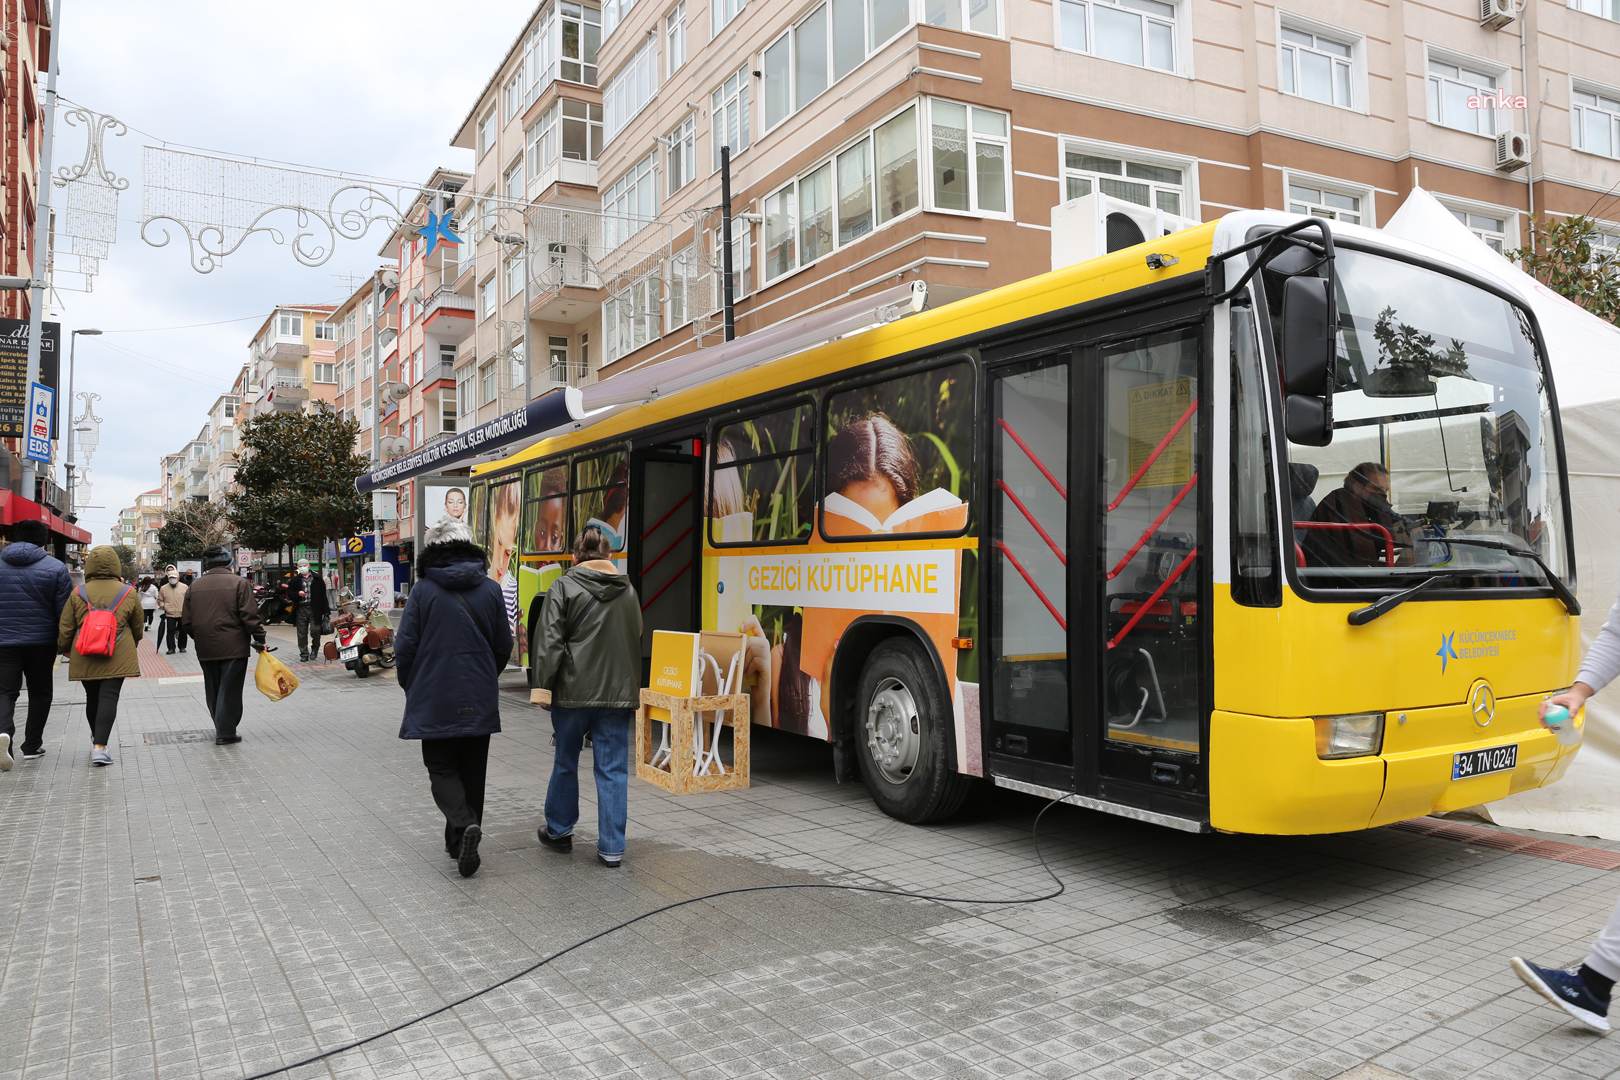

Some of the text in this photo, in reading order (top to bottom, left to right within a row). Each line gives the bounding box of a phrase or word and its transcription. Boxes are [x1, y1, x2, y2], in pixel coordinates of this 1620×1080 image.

[1144, 387, 1173, 400] DİKKAT
[422, 446, 441, 464] KÜLTÜR
[440, 443, 448, 457] VE
[447, 436, 468, 455] SOSYAL
[467, 428, 485, 449] İŞLER
[484, 407, 528, 440] MÜDÜRLÜĞÜ
[30, 438, 49, 454] EDS
[365, 574, 390, 582] DİKKAT
[749, 557, 938, 593] GEZİCİ KÜTÜPHANE
[1459, 629, 1516, 644] KÜÇÜKÇEKMECE
[1459, 643, 1499, 659] BELEDİYESİ
[663, 666, 678, 676] GEZİCİ
[657, 676, 682, 690] KÜTÜPHANE
[1460, 755, 1473, 775] 34
[1478, 751, 1491, 772] TN
[1493, 747, 1516, 769] 0241
